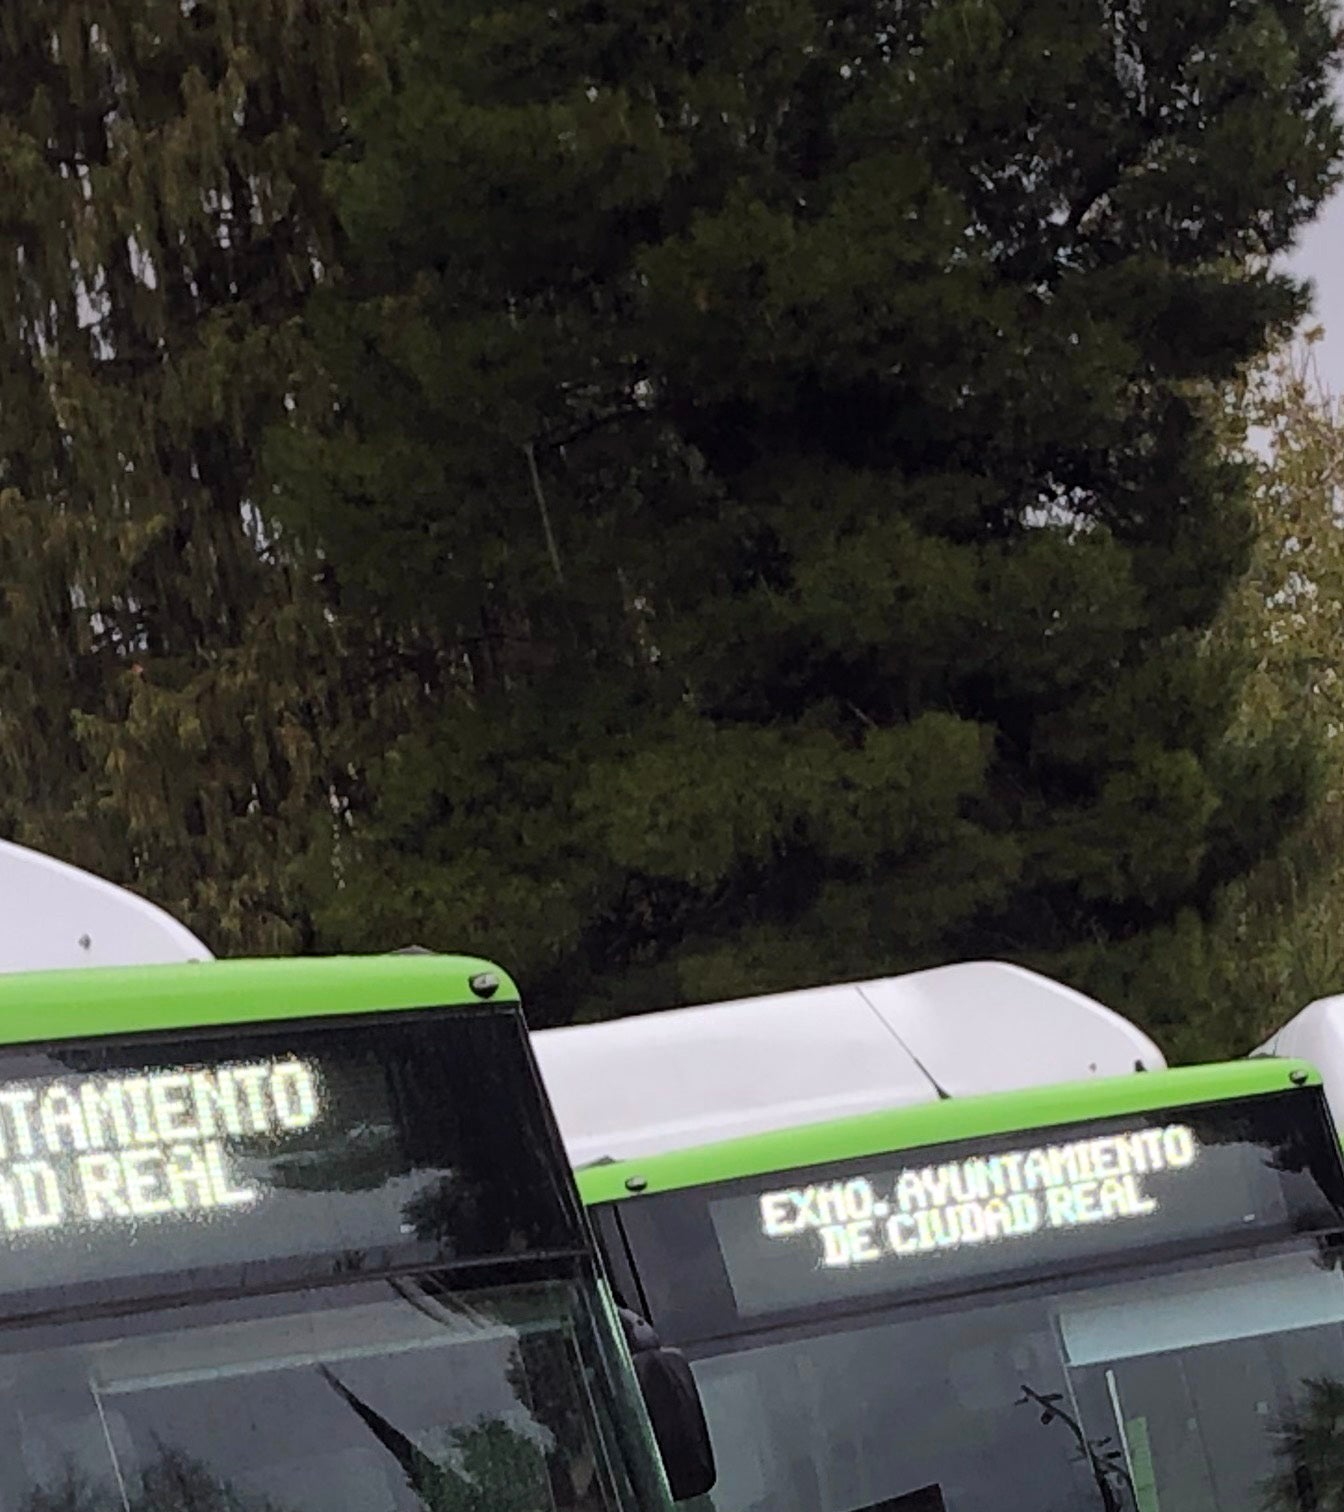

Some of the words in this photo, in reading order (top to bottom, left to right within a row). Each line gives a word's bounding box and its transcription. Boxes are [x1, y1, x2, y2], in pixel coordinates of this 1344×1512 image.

[76, 1140, 260, 1222] REAL
[896, 1125, 1196, 1208] AYUNTAMIENTO
[820, 1222, 876, 1266] DE
[886, 1198, 1040, 1254] CIUDAD
[1046, 1174, 1158, 1226] REAL
